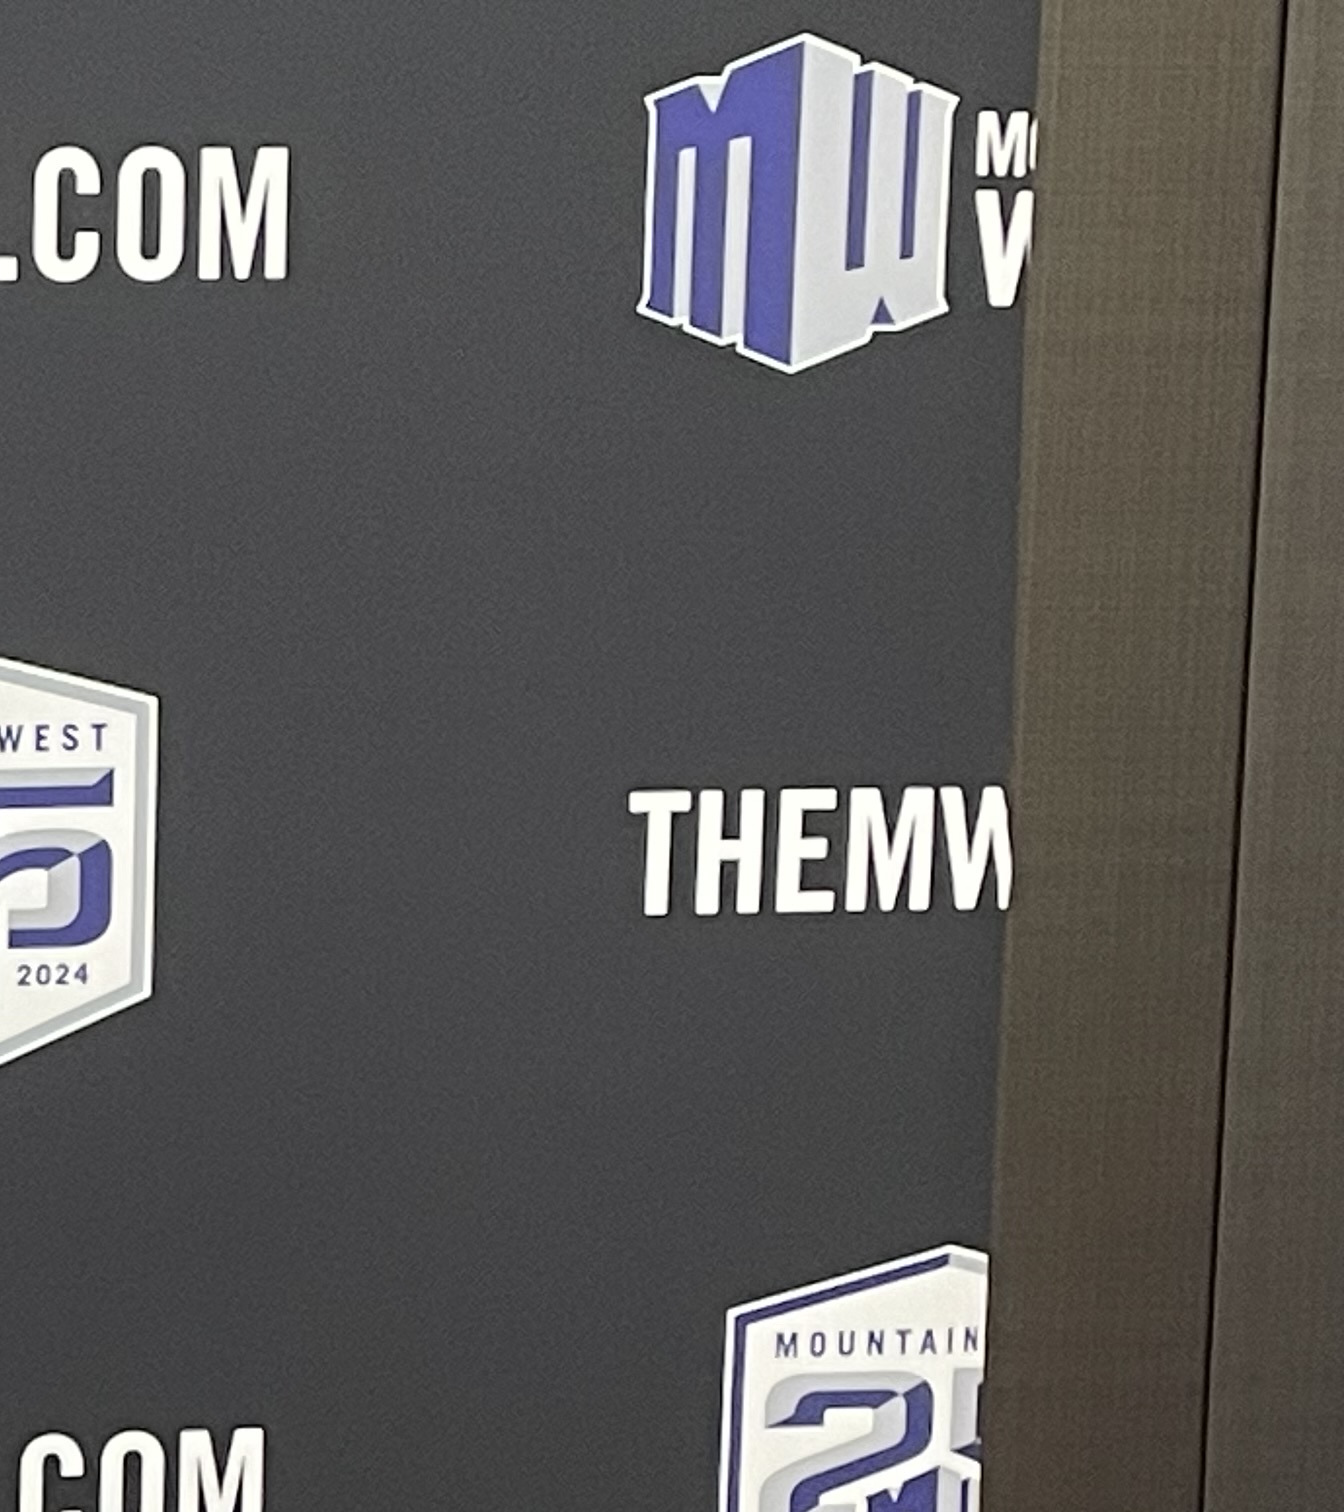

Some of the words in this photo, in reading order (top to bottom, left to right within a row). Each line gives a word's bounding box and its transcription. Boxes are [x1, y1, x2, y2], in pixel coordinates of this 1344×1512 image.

[628, 786, 1012, 916] THEMW
[16, 963, 89, 987] 2024
[774, 1328, 978, 1360] MOUNTAIN
